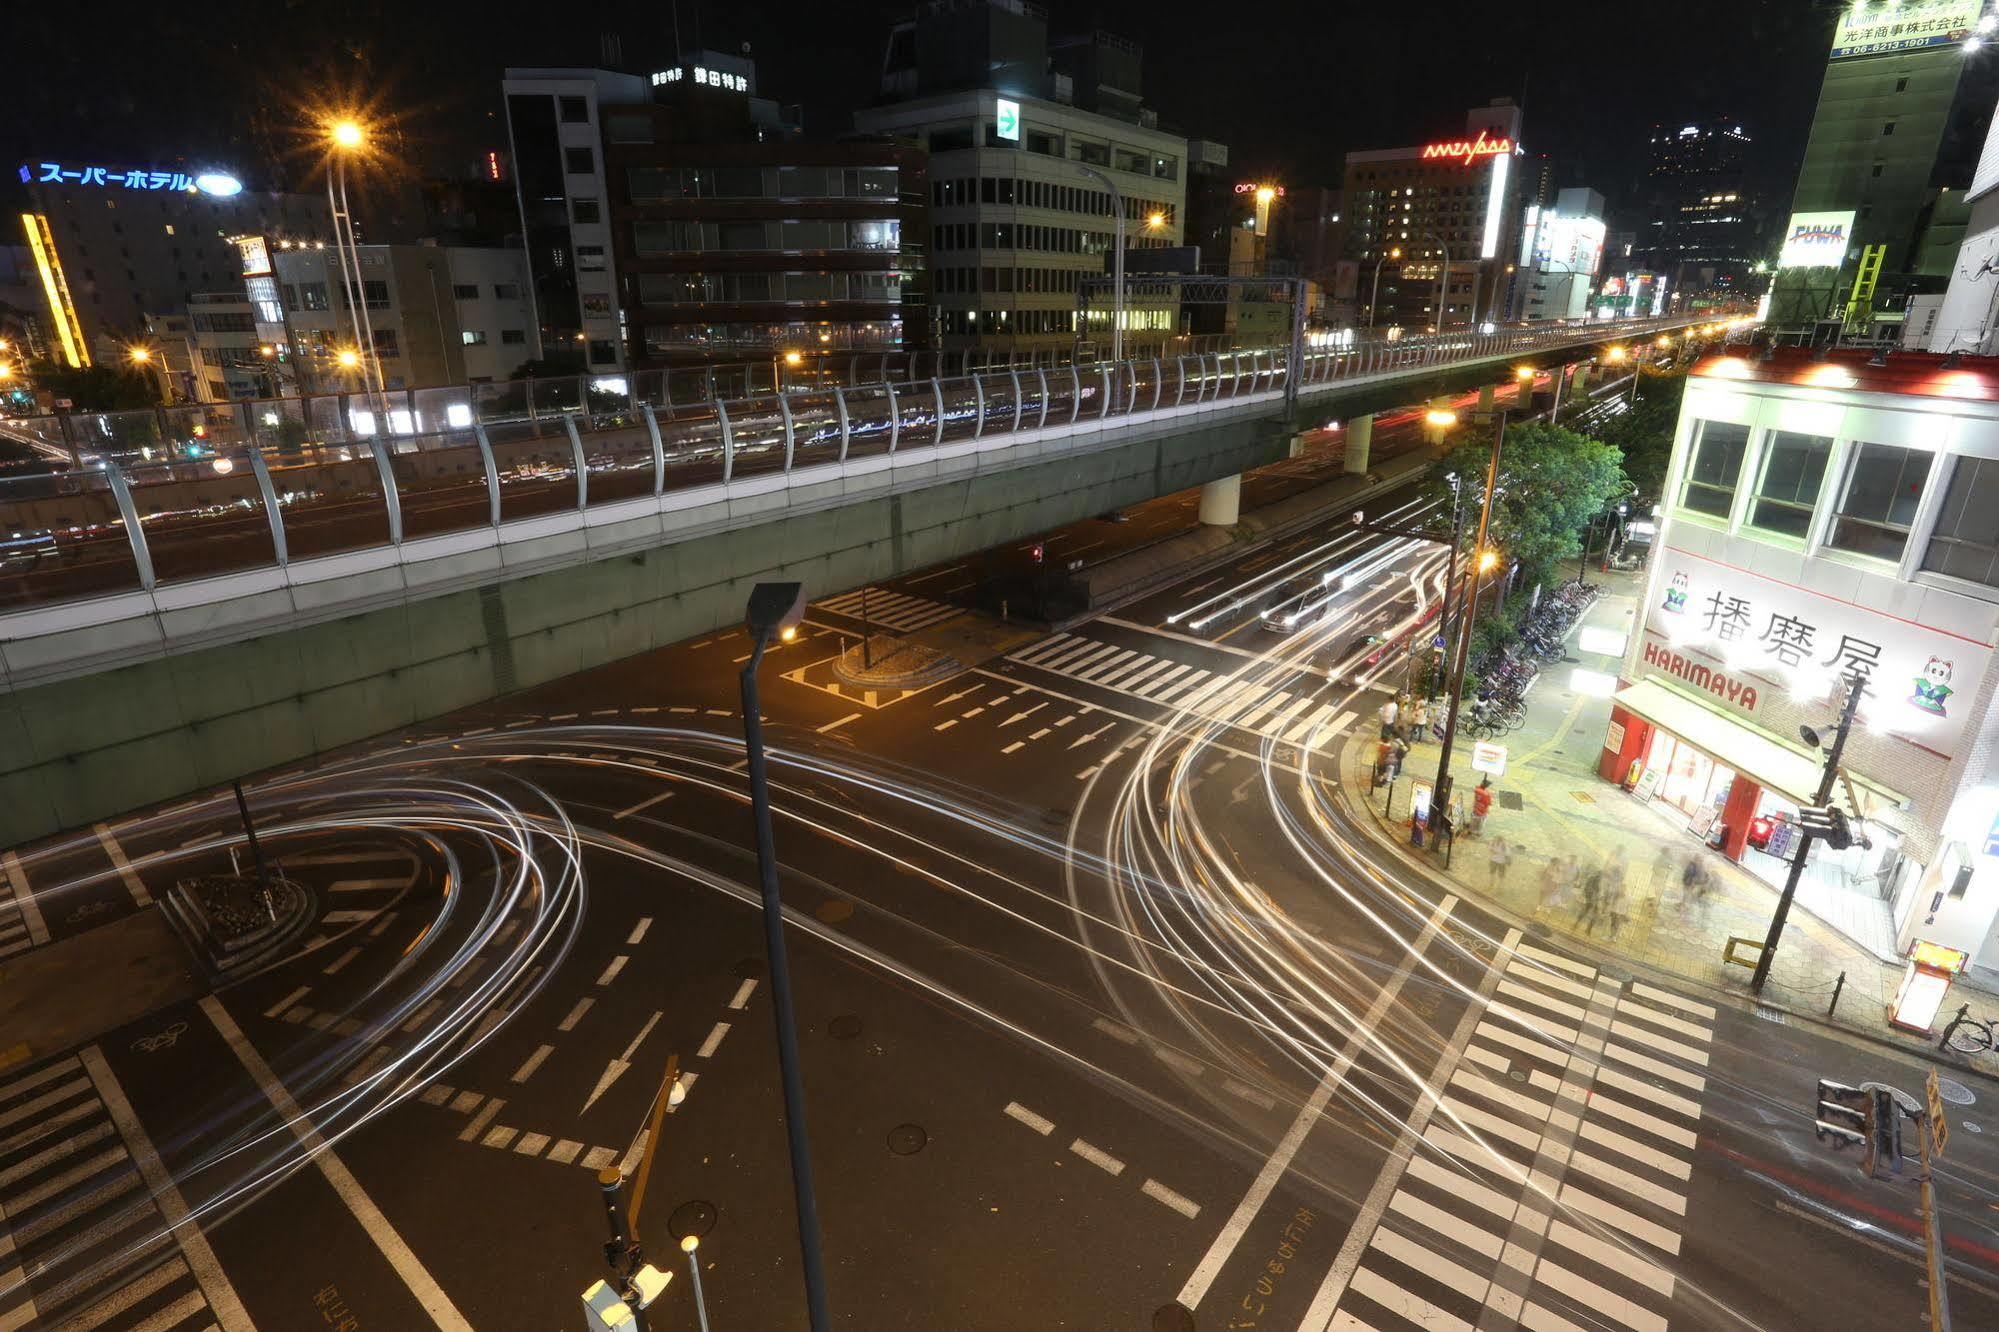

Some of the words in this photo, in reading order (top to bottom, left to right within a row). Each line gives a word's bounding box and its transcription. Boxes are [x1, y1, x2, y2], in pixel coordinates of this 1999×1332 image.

[1843, 15, 1967, 43] 光洋商事株式会社
[1852, 38, 1930, 55] 06-6213-1901
[39, 162, 193, 192] スーパーホテル
[1702, 590, 1883, 699] 播磨屋
[1643, 642, 1758, 712] HARIMAYA
